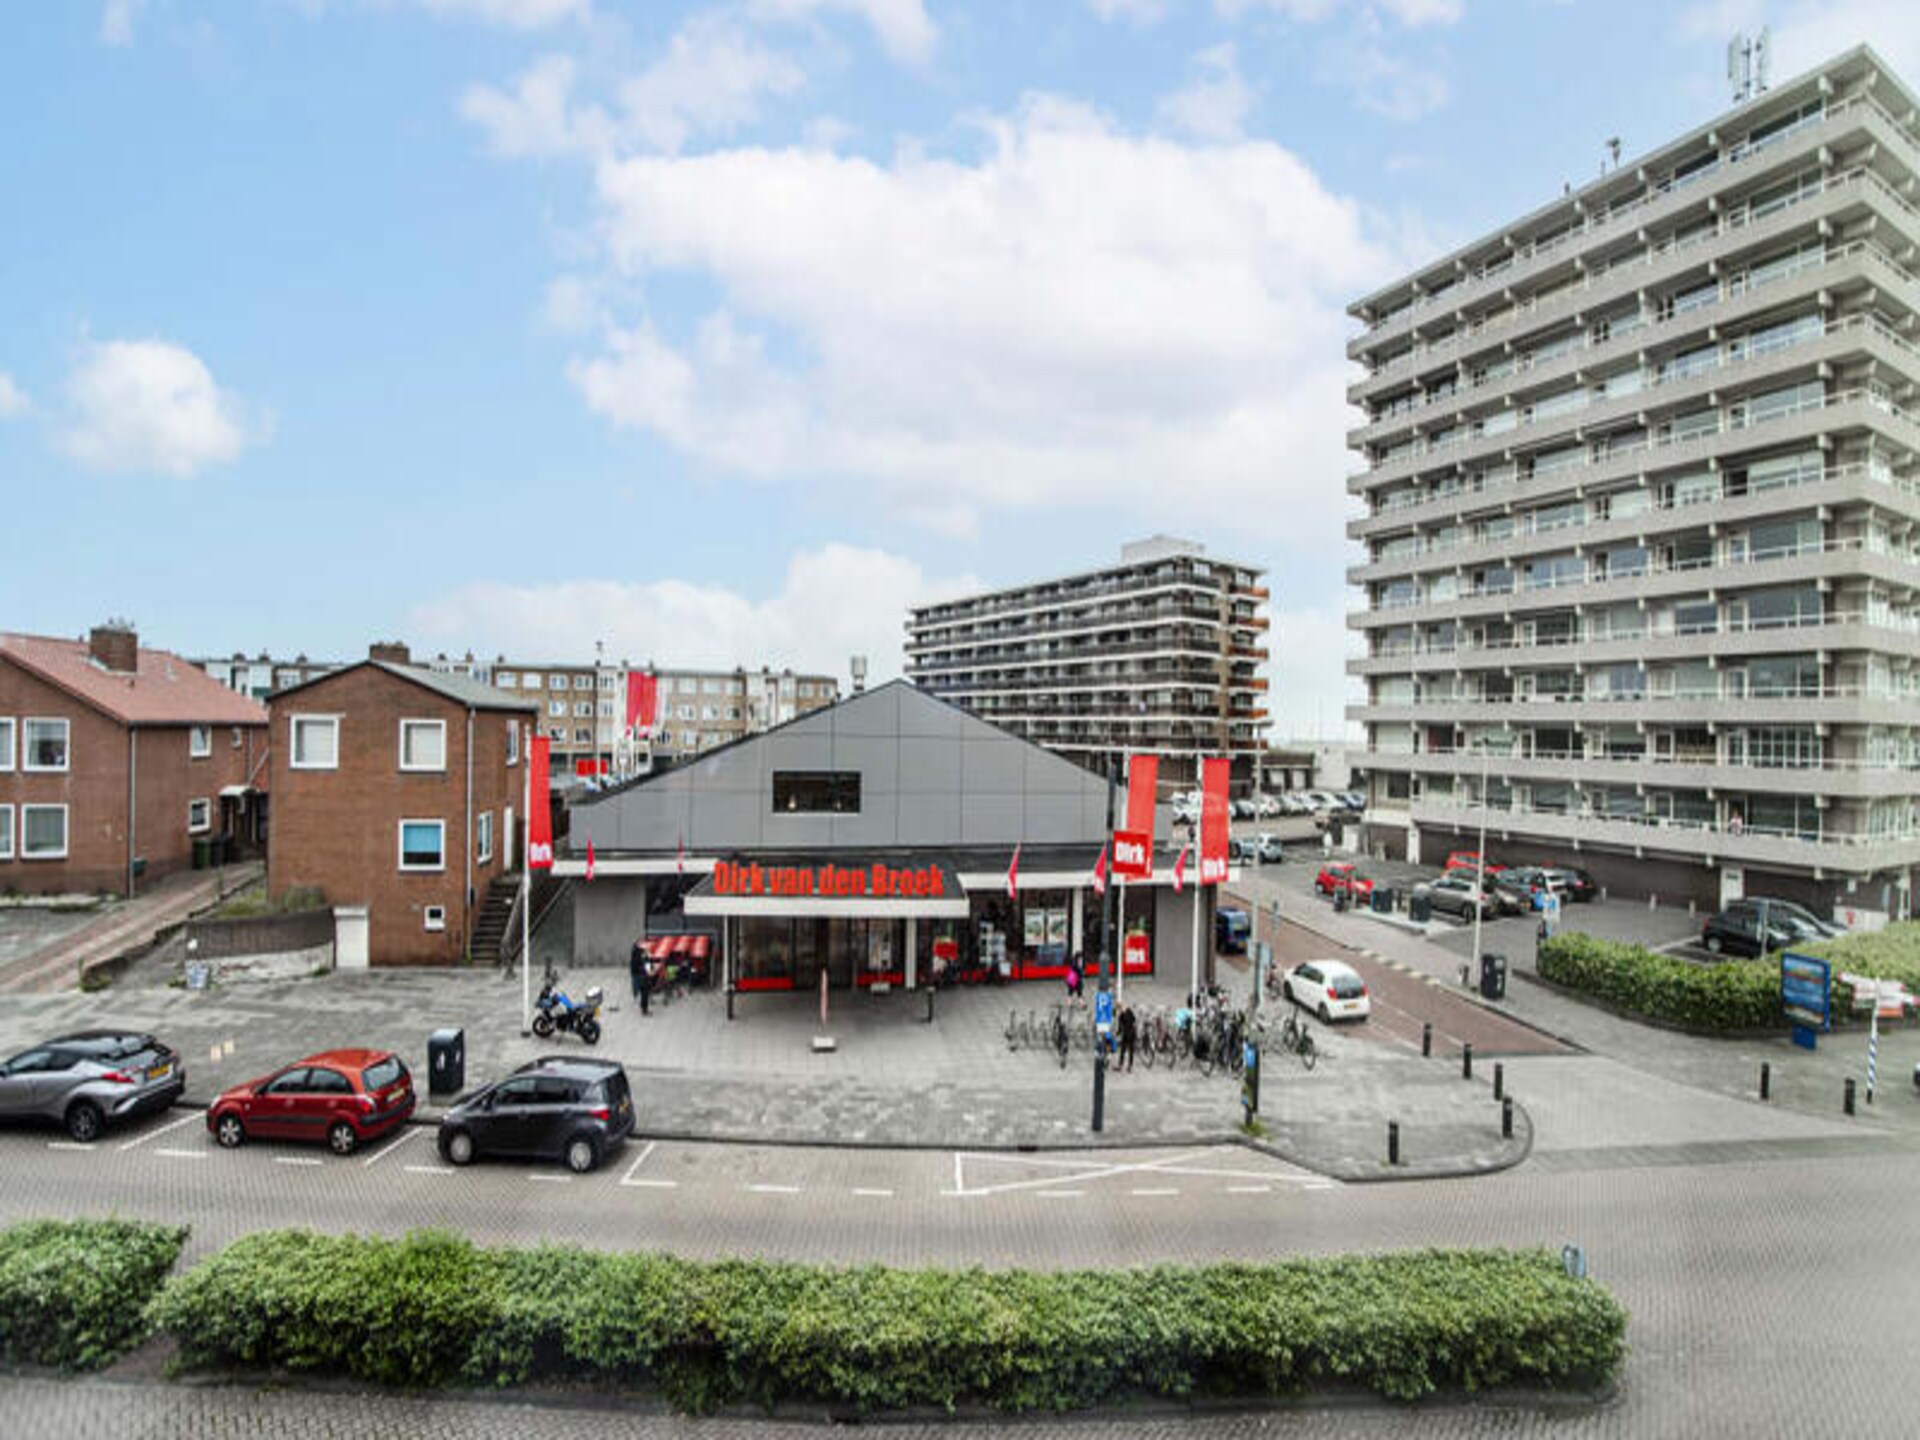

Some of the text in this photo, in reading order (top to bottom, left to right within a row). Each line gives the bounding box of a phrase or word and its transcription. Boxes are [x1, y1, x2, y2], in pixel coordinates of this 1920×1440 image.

[1115, 840, 1145, 865] Dirk
[713, 860, 944, 896] Dirk van den Broek
